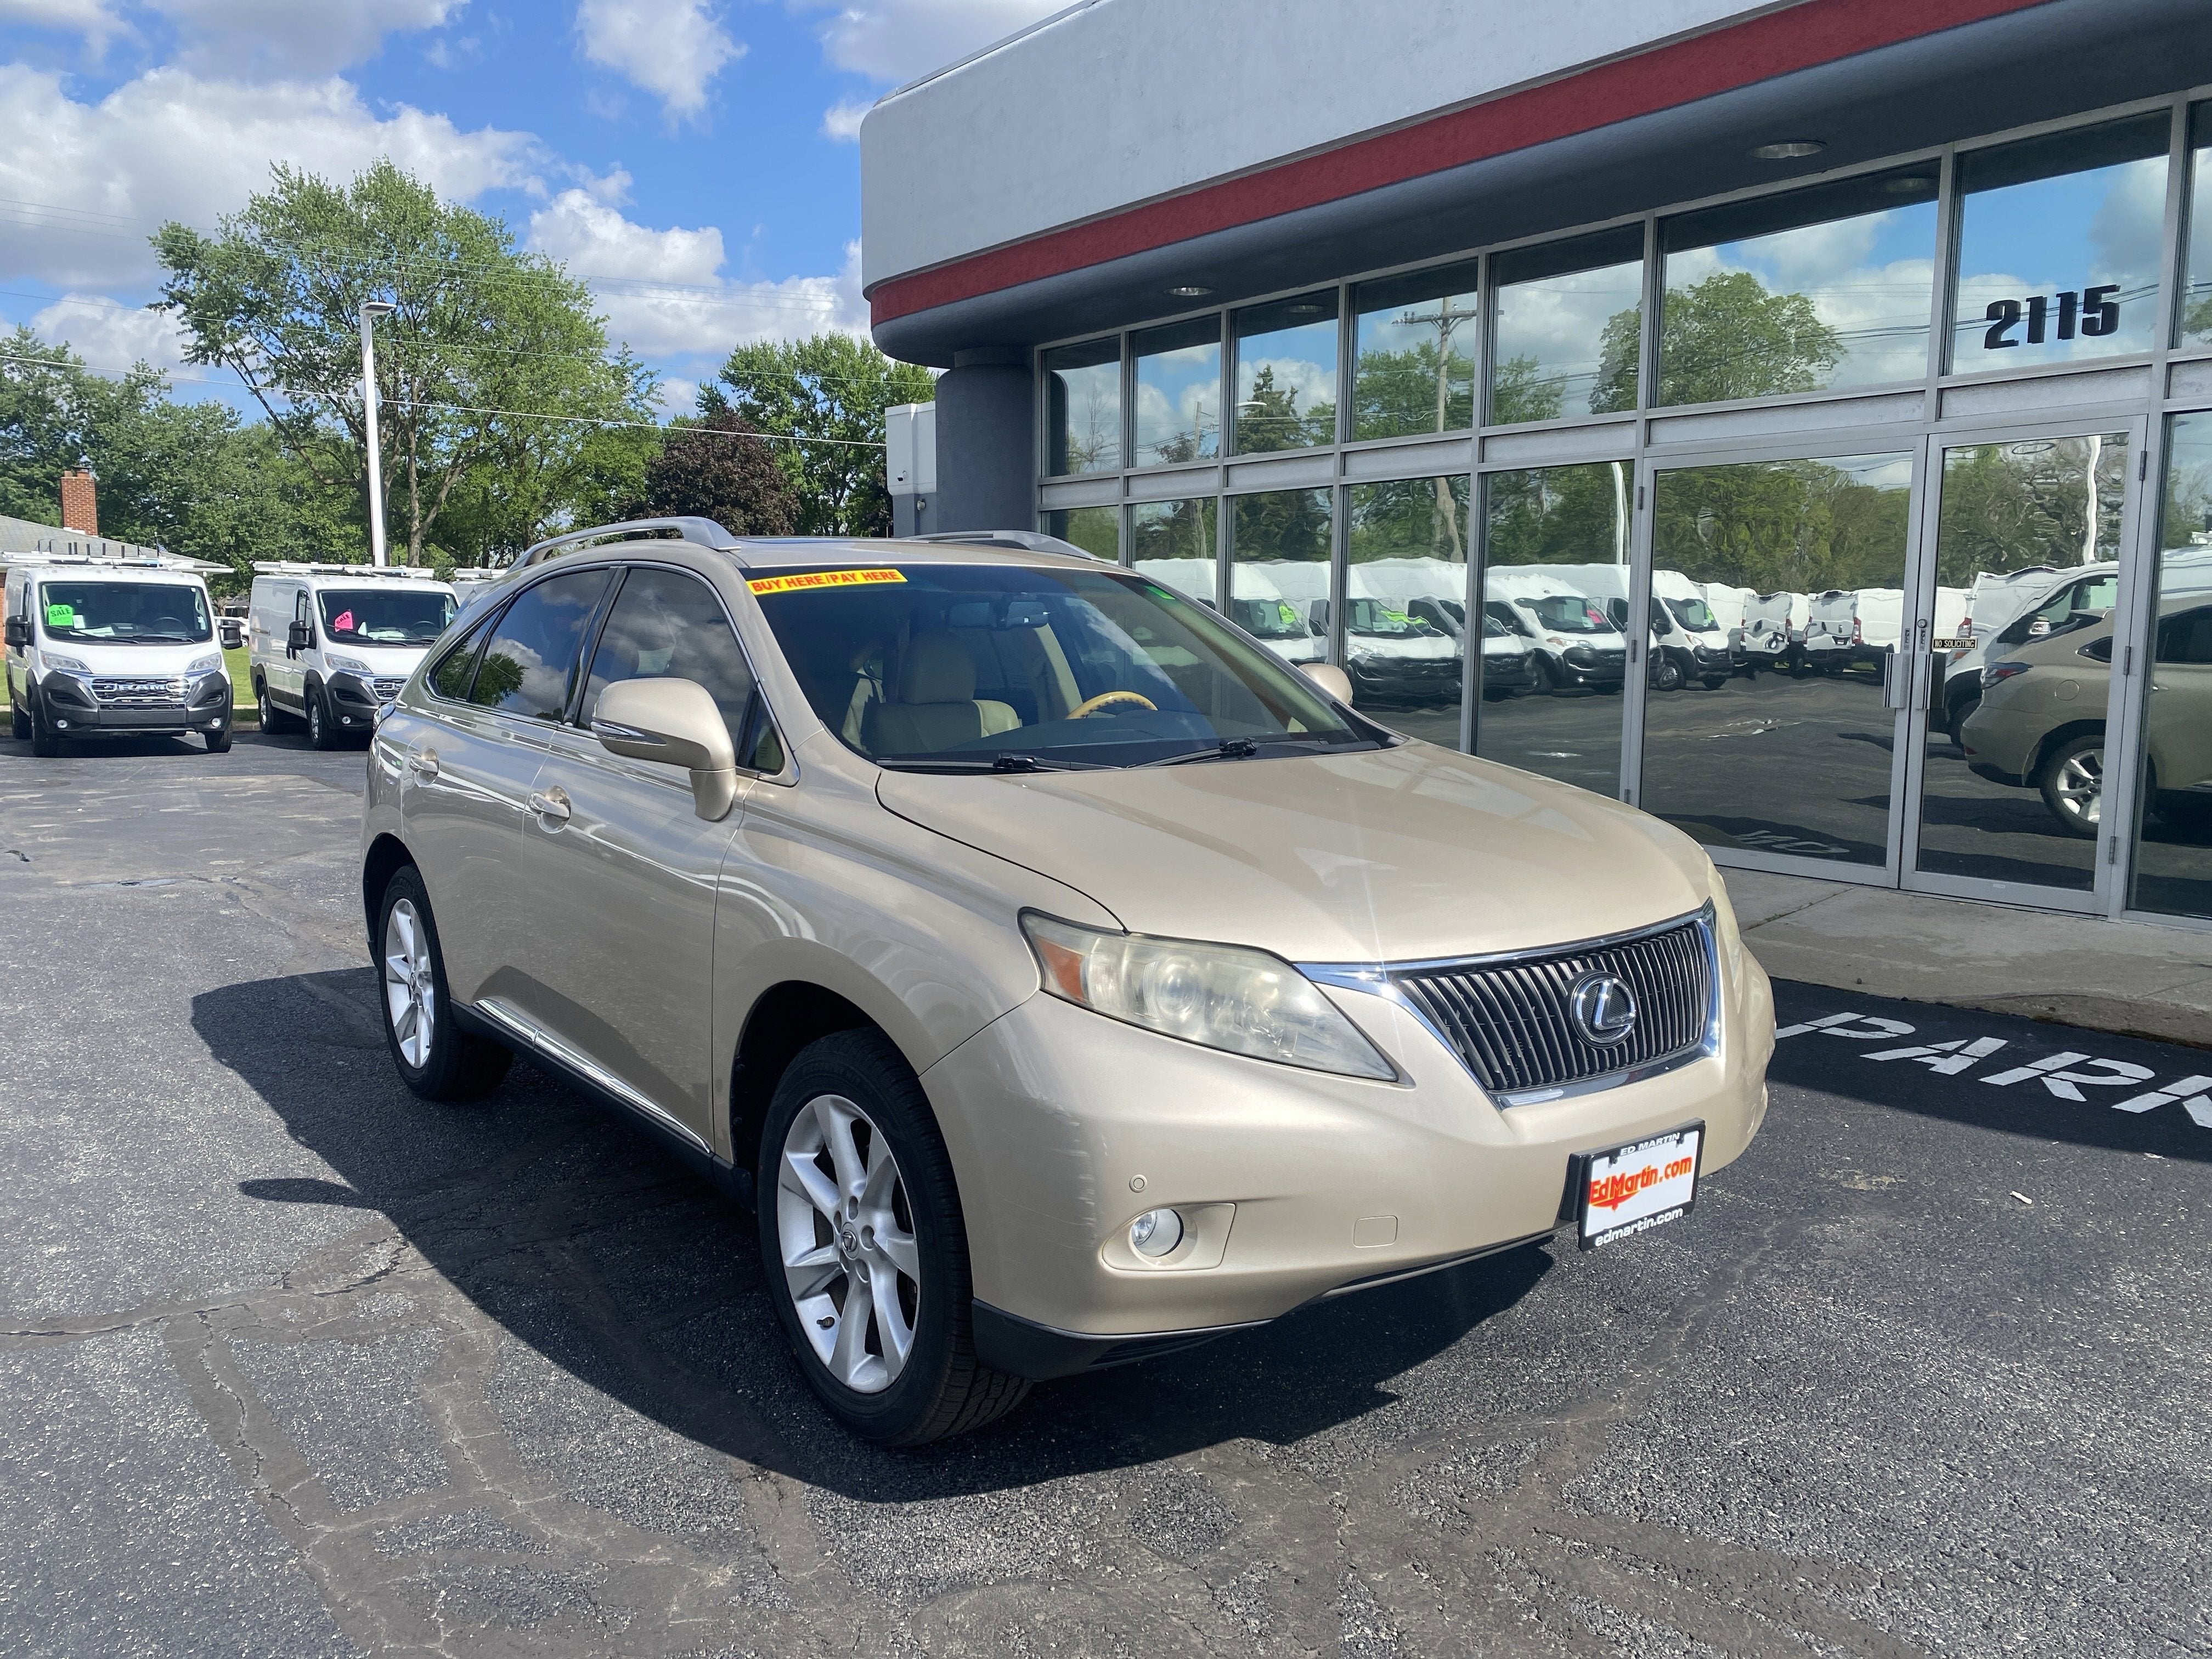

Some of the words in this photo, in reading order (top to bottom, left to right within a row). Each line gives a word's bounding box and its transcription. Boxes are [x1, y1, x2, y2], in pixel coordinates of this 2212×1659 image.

[1984, 284, 2121, 349] 2115
[751, 579, 782, 592] BUY
[860, 571, 902, 582] HERE
[50, 607, 71, 617] SALE
[1934, 639, 1943, 648] NO
[1944, 639, 1975, 648] SOLICITING
[1620, 1145, 1637, 1156] ED
[1638, 1132, 1681, 1152] MARTIN
[1589, 1156, 1692, 1204] EdMartin.com
[1594, 1207, 1684, 1247] edmartin.com
